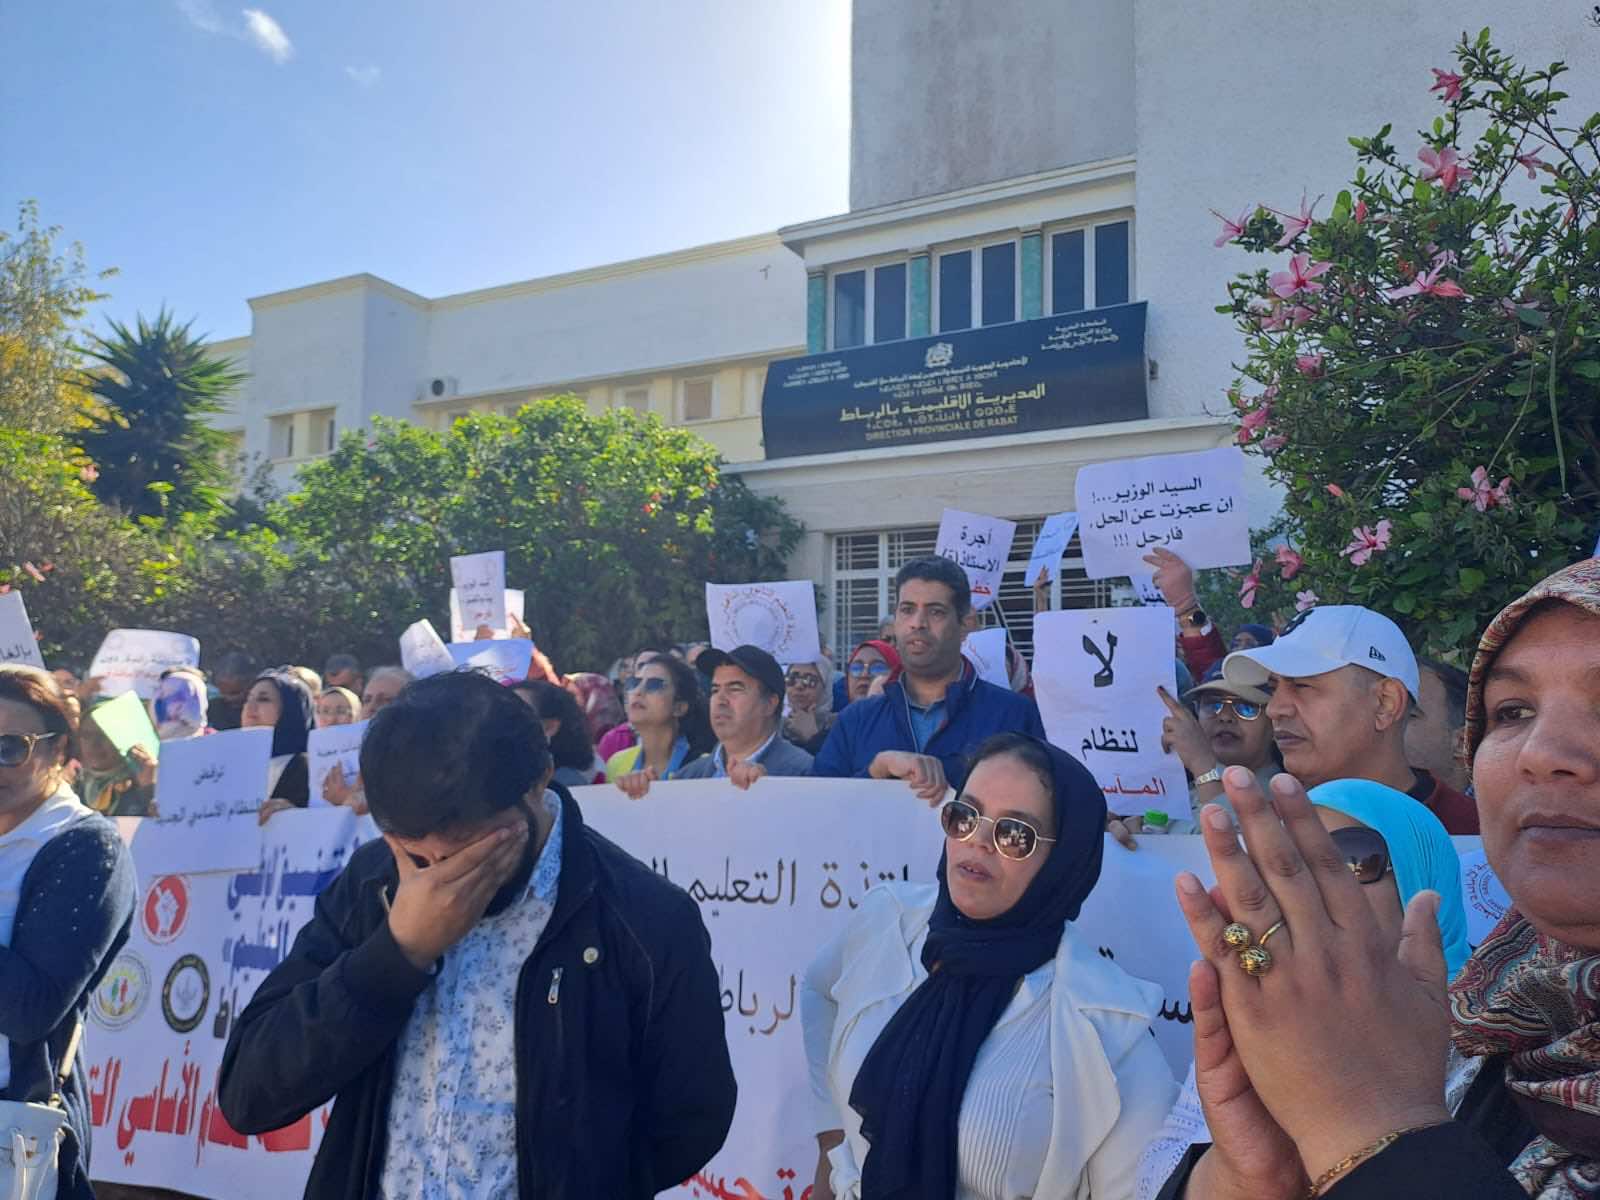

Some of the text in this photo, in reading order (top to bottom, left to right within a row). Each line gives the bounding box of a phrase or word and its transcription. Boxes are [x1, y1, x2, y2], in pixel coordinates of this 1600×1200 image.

[839, 405, 900, 422] بالرباط
[912, 420, 971, 435] PROVINCIALE
[972, 418, 986, 428] DE
[987, 415, 1019, 426] RABAT
[1159, 477, 1202, 496] السيد
[1131, 508, 1157, 524] عن
[1159, 503, 1213, 519] عجزت
[1136, 526, 1183, 548] فارحل
[1082, 631, 1118, 687] لا
[1081, 726, 1139, 760] لنظام
[1102, 773, 1167, 796] المآس
[688, 857, 797, 916] التعليم
[720, 965, 796, 1035] لرباط
